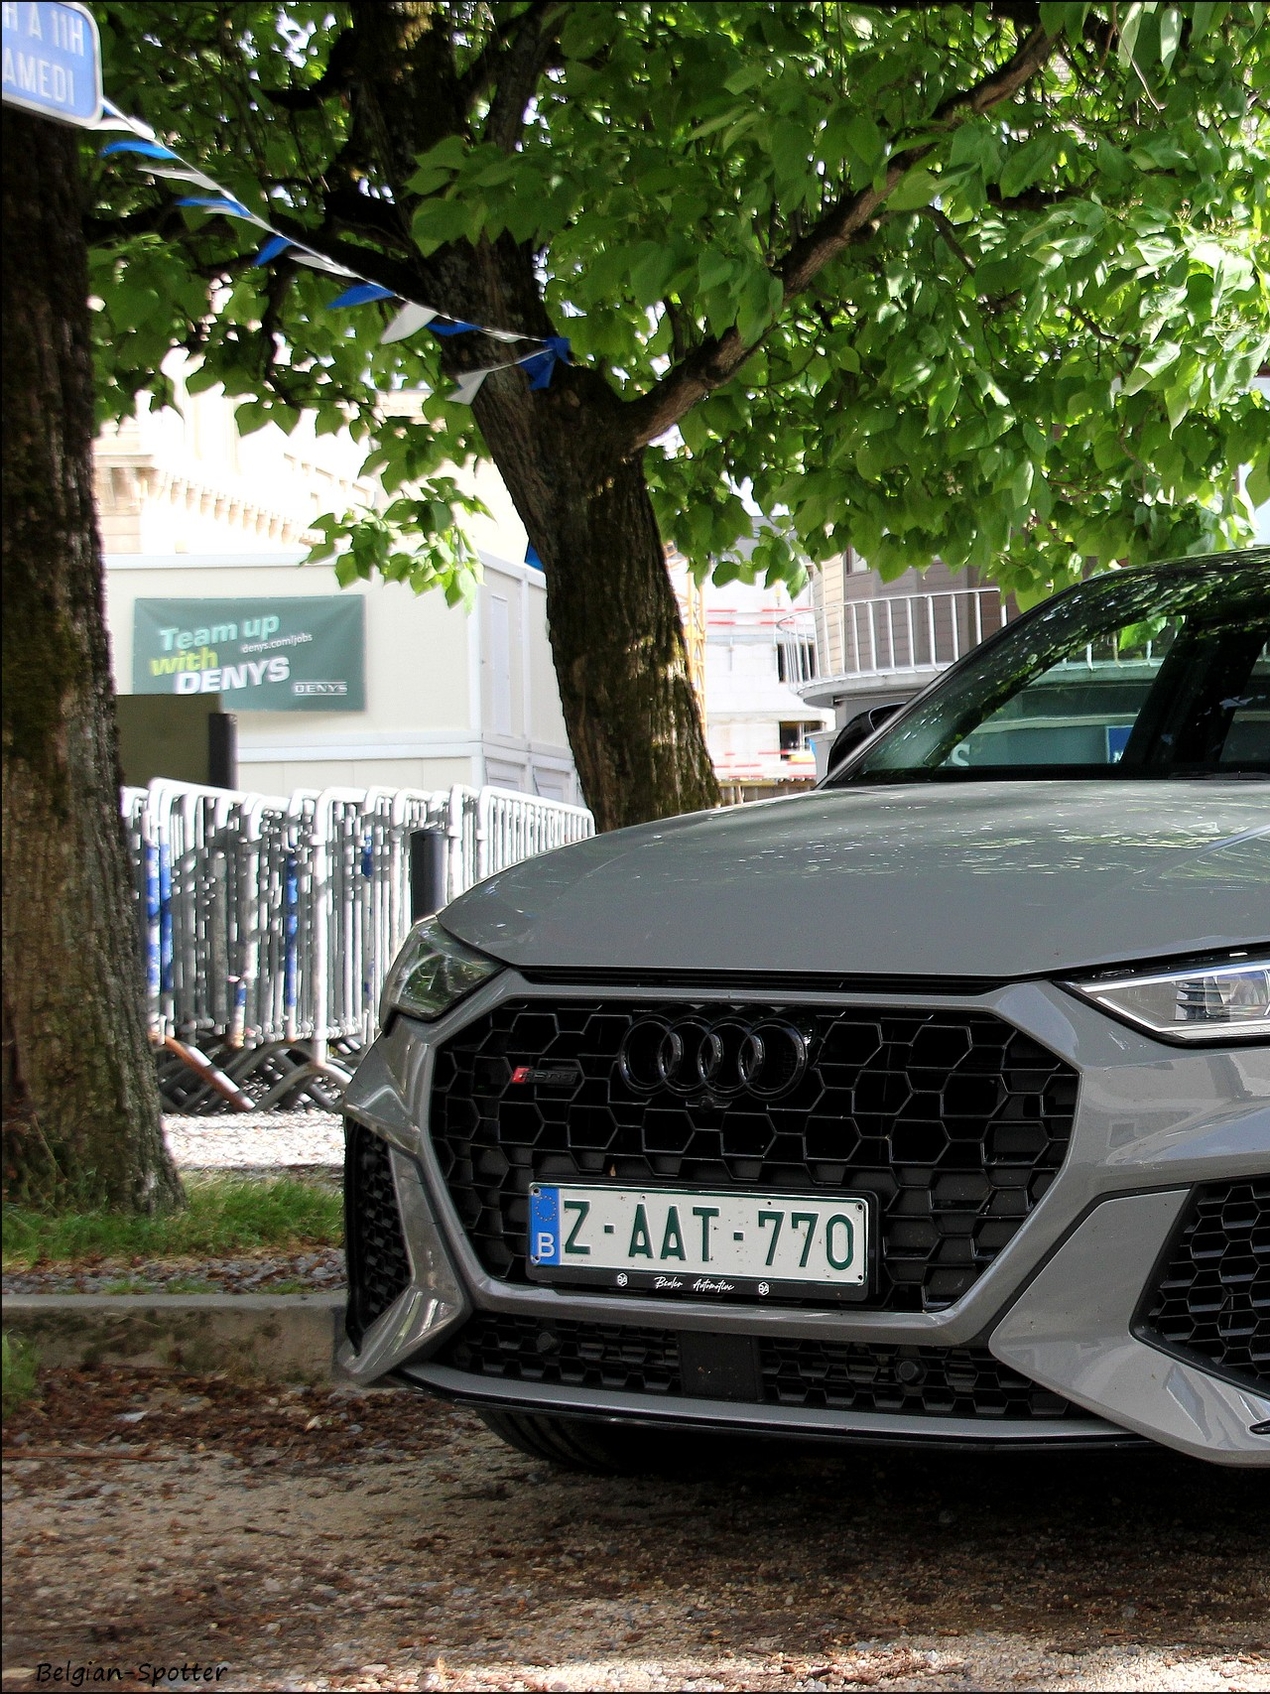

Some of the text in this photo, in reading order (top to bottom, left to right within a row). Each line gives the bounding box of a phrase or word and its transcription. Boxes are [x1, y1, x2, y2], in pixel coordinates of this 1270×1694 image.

[50, 9, 85, 57] 11H
[160, 615, 280, 651] Team up
[242, 633, 313, 653] denys.com/jobs
[152, 647, 219, 677] with
[176, 656, 290, 695] DENYS
[294, 684, 348, 693] DENYS
[537, 1232, 556, 1258] B
[563, 1199, 856, 1271] Z-AAT-770
